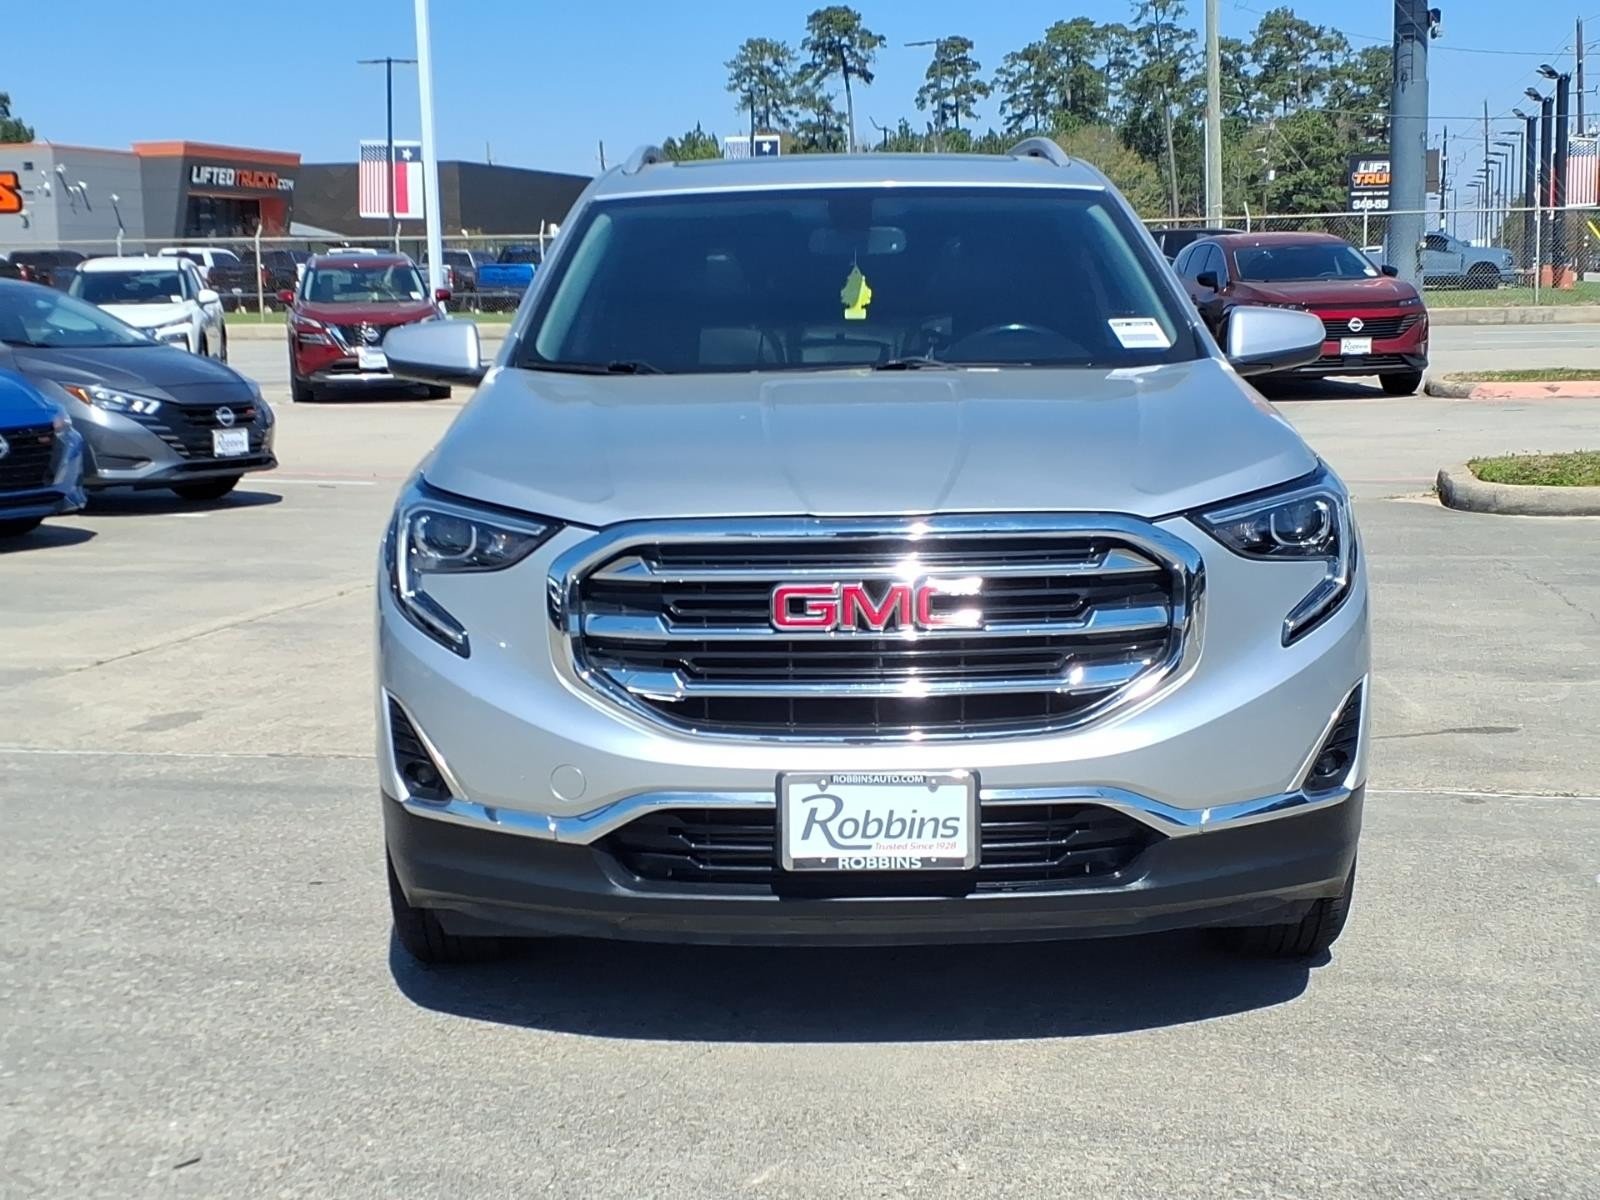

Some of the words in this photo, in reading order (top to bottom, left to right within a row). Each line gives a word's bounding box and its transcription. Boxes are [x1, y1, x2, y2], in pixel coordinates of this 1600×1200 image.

[1354, 173, 1391, 184] TRU
[772, 577, 983, 631] GMC
[832, 775, 924, 784] ROBBINSAUTO.COM
[801, 794, 960, 850] Robbins
[875, 842, 908, 850] Trusted
[910, 842, 934, 850] Since
[936, 841, 957, 850] 1928
[838, 857, 922, 869] ROBBINS
